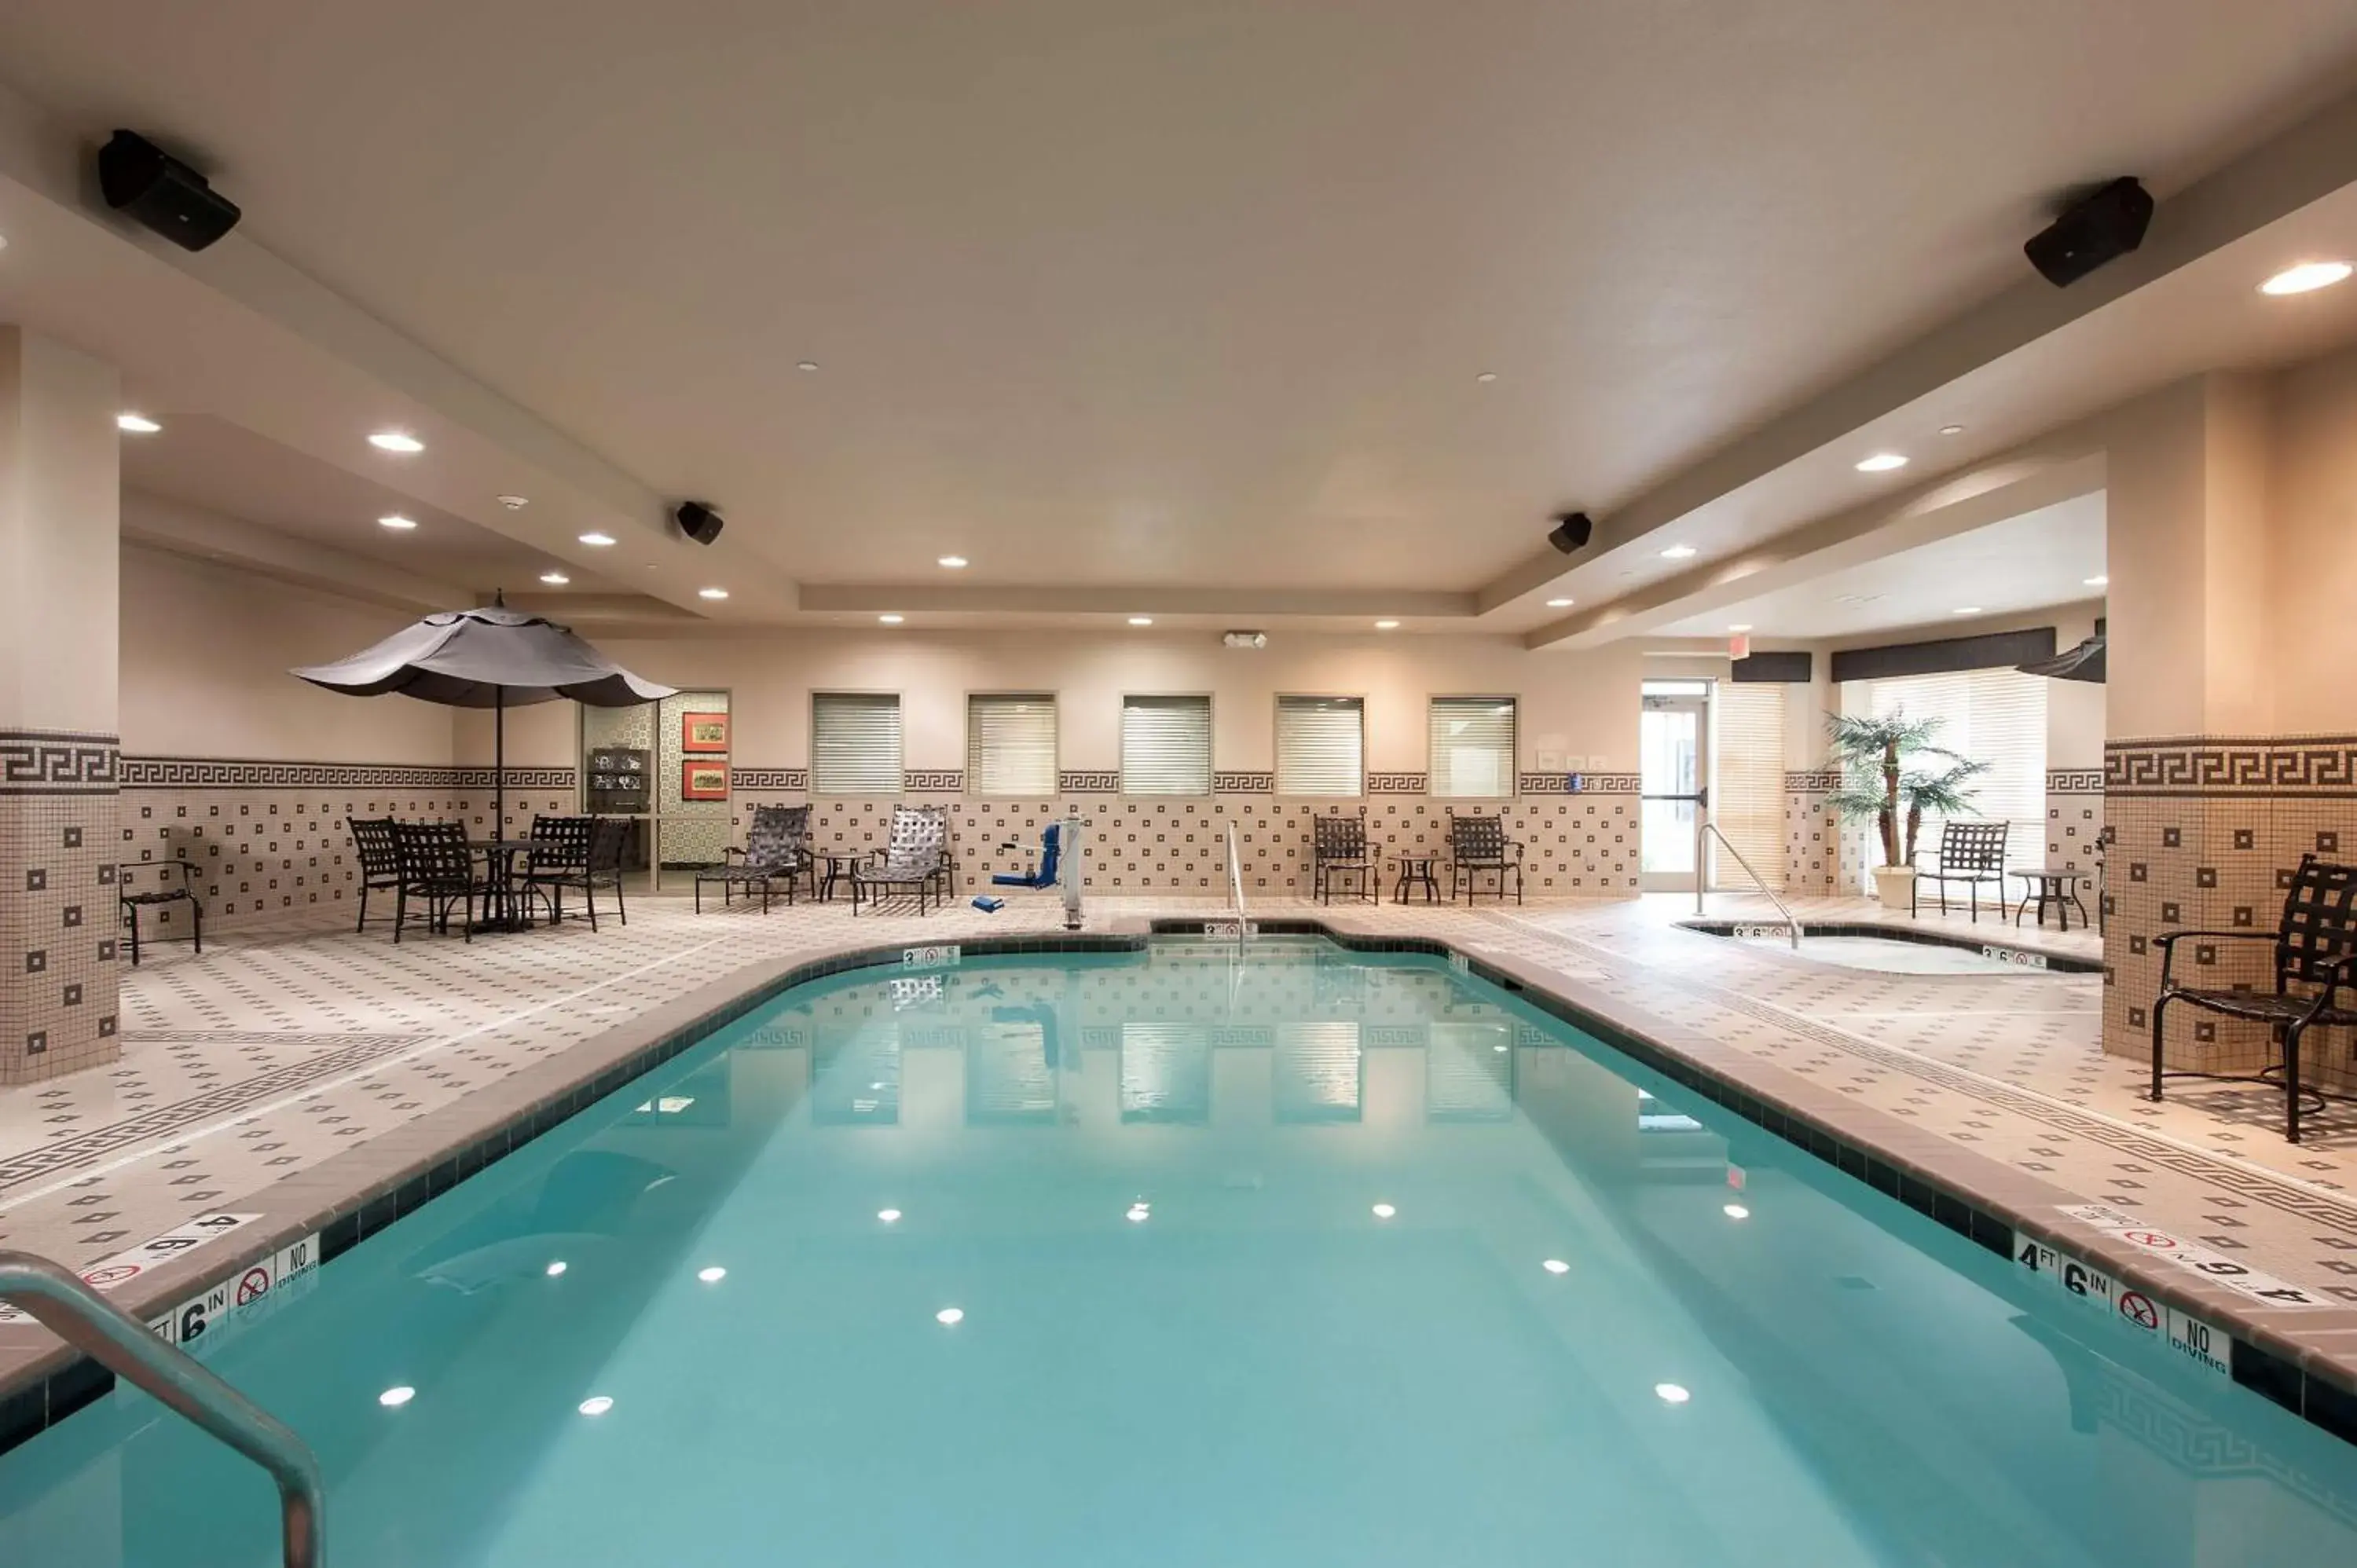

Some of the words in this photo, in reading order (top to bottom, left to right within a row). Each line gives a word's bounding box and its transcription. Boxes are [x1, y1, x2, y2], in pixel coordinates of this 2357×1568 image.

[194, 1216, 240, 1227] 4
[145, 1240, 198, 1250] 6
[289, 1243, 307, 1272] NO
[277, 1259, 317, 1289] DIVING
[2018, 1244, 2039, 1271] 4
[2040, 1250, 2056, 1267] FT
[2064, 1263, 2088, 1297] 6
[2090, 1271, 2106, 1295] IN
[2195, 1262, 2249, 1275] 6
[2254, 1289, 2311, 1303] 4
[181, 1303, 207, 1343] 6
[208, 1289, 224, 1313] IN
[2187, 1319, 2209, 1354] NO
[2172, 1337, 2227, 1375] DIVING
